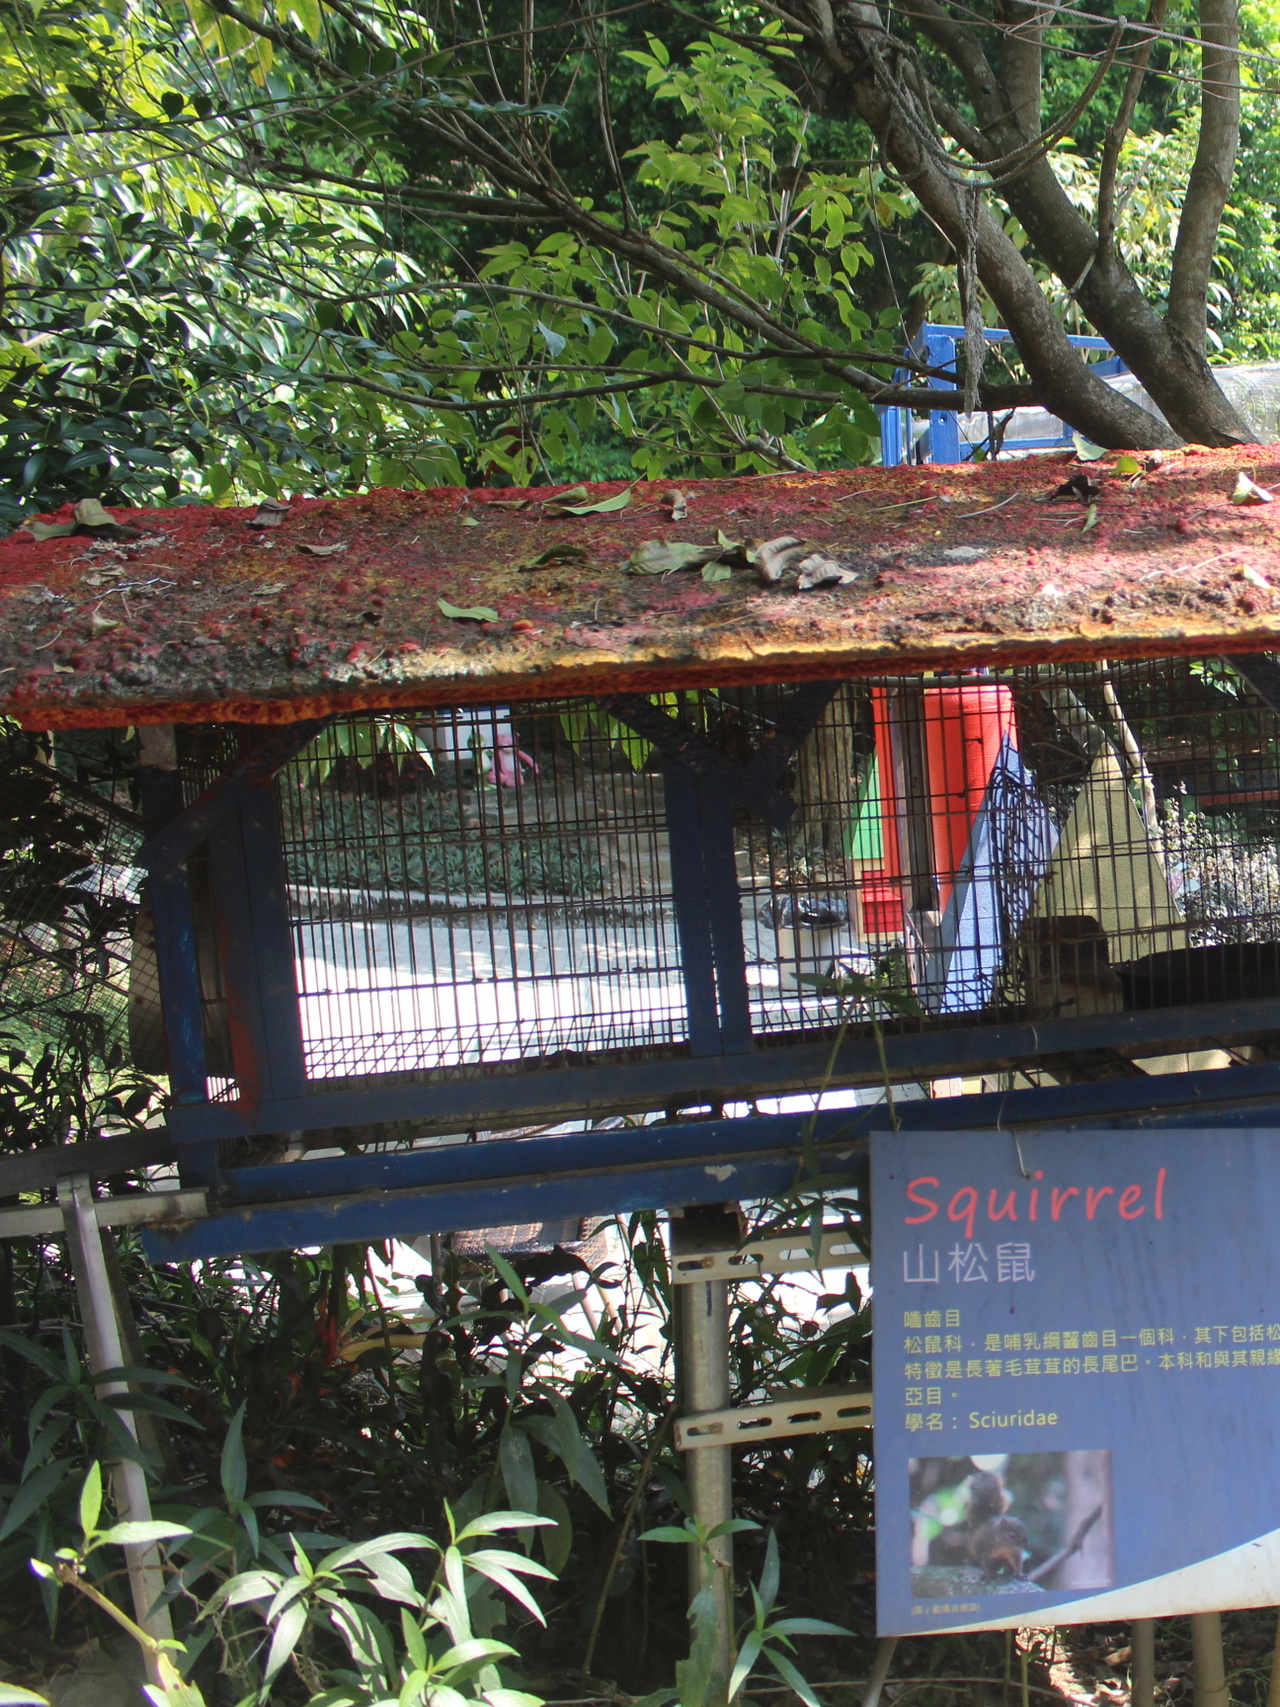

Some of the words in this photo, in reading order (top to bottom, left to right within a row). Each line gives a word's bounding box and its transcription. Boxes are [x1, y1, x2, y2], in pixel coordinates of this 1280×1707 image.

[905, 1168, 1166, 1239] Squirrel
[903, 1242, 1035, 1284] 山松鼠
[905, 1387, 958, 1406] 亞目。
[969, 1409, 1058, 1430] Sciuridae
